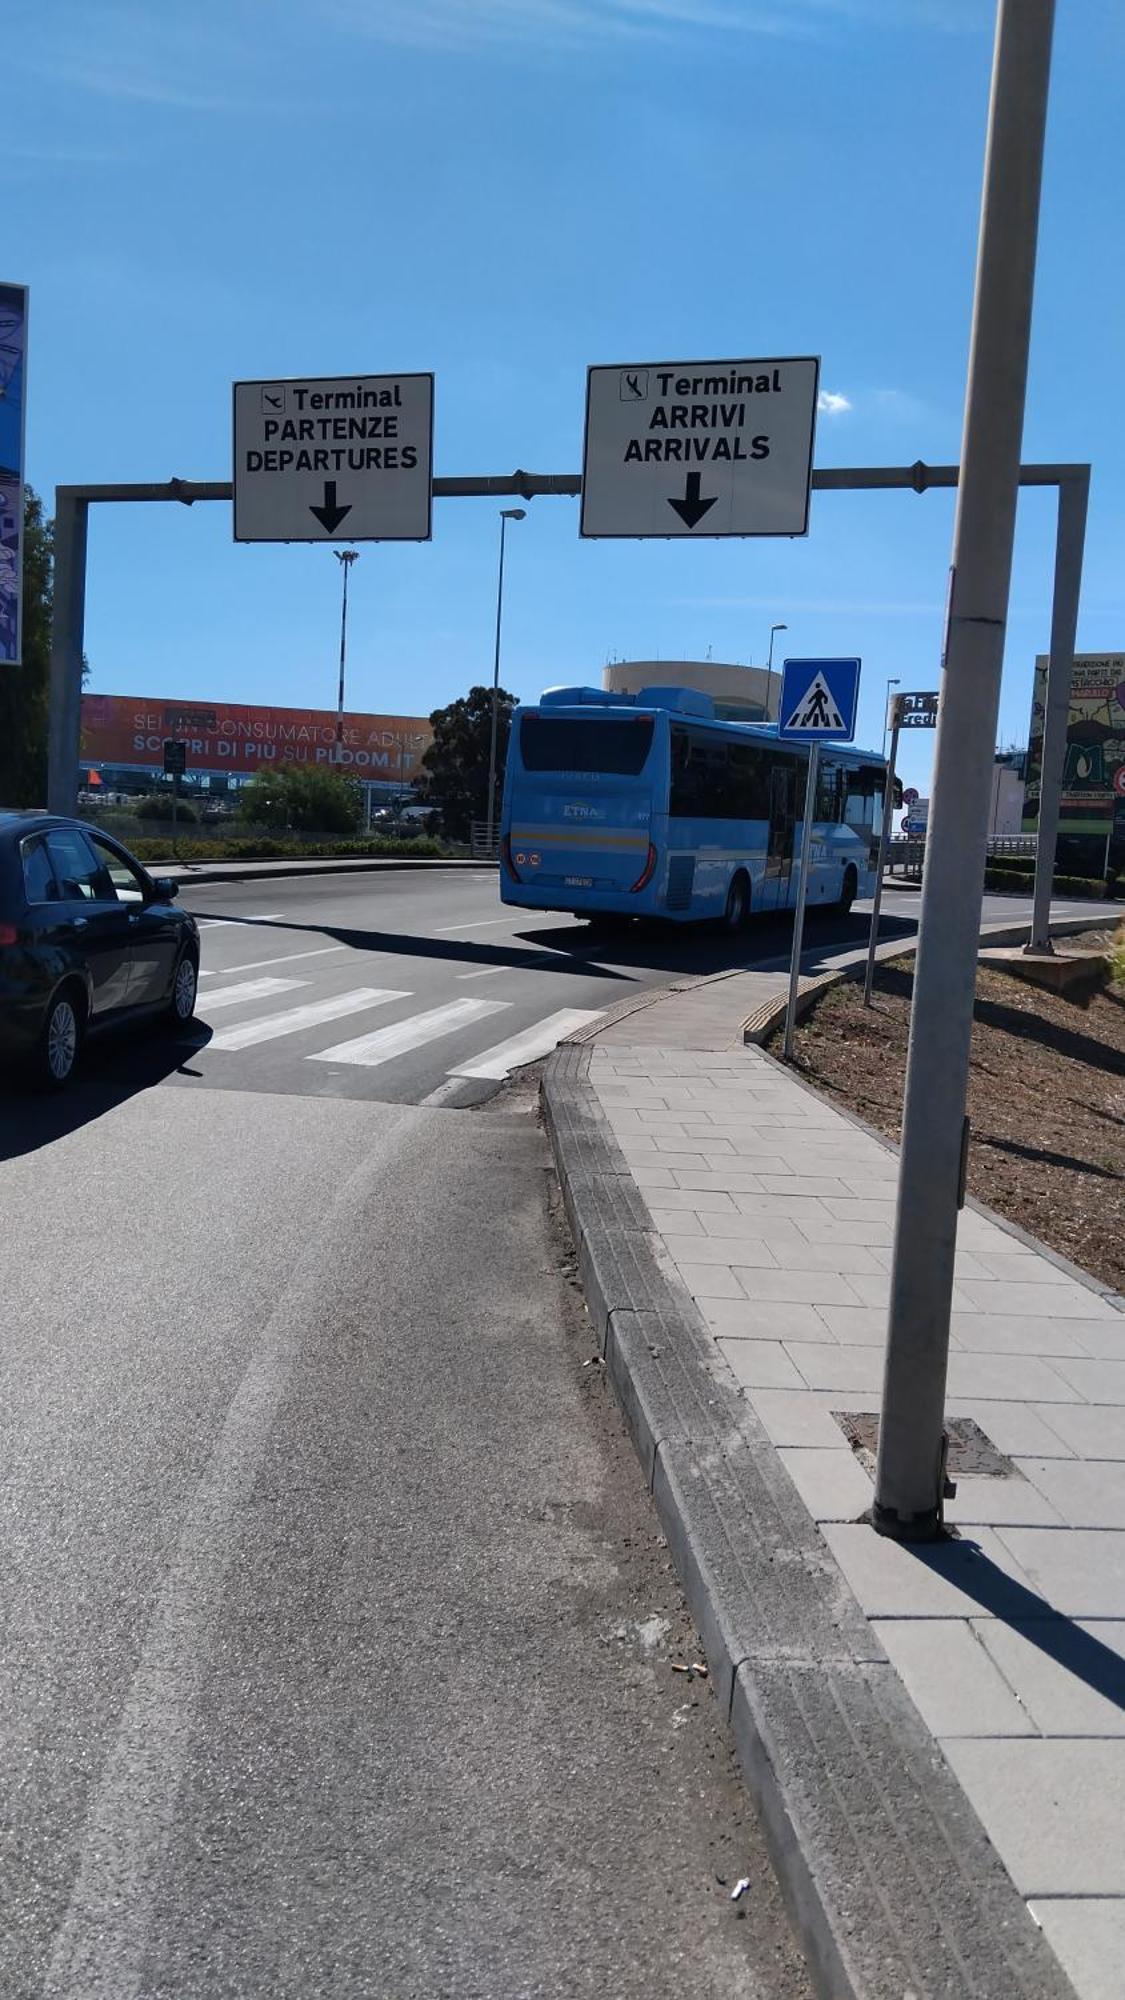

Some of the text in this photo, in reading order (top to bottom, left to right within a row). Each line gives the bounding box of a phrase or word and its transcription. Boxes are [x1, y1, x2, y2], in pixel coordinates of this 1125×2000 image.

[656, 369, 782, 396] Terminal
[293, 385, 402, 410] Terminal
[264, 415, 398, 442] PARTENZE
[649, 403, 746, 429] ARRIVI
[246, 446, 418, 472] DEPARTURES
[624, 435, 771, 463] ARRIVALS
[134, 714, 162, 731] SEI
[366, 730, 429, 750] ADULT
[217, 741, 237, 757] DI
[245, 741, 276, 760] PIÙ
[282, 745, 308, 762] SU
